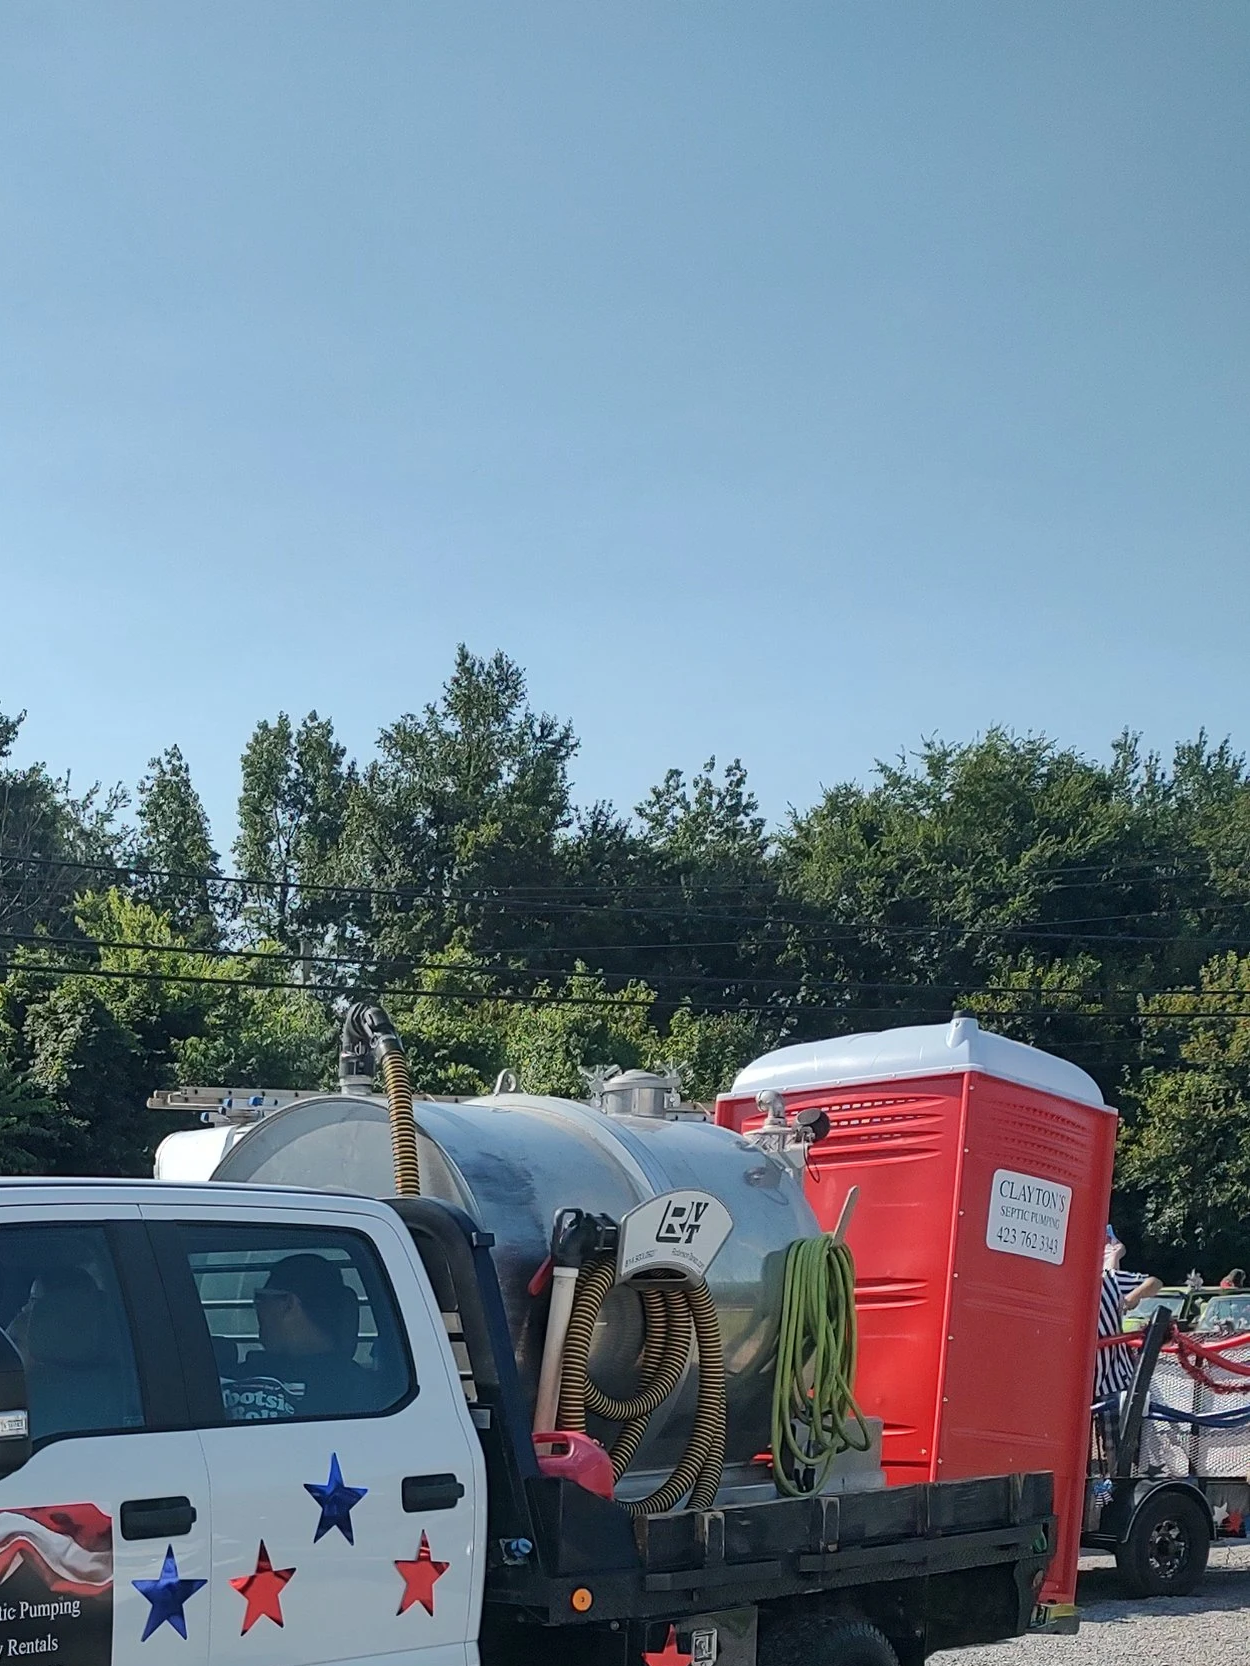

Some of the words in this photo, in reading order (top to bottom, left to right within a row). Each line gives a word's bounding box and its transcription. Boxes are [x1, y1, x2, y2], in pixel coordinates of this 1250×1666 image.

[999, 1179, 1067, 1213] CLAYTON'S
[1000, 1205, 1030, 1222] SEPTIC
[996, 1226, 1017, 1244] 423
[1020, 1230, 1038, 1249] 762
[1039, 1235, 1059, 1255] 3343
[19, 1599, 82, 1621] Pumping
[7, 1632, 59, 1657] Rentals
